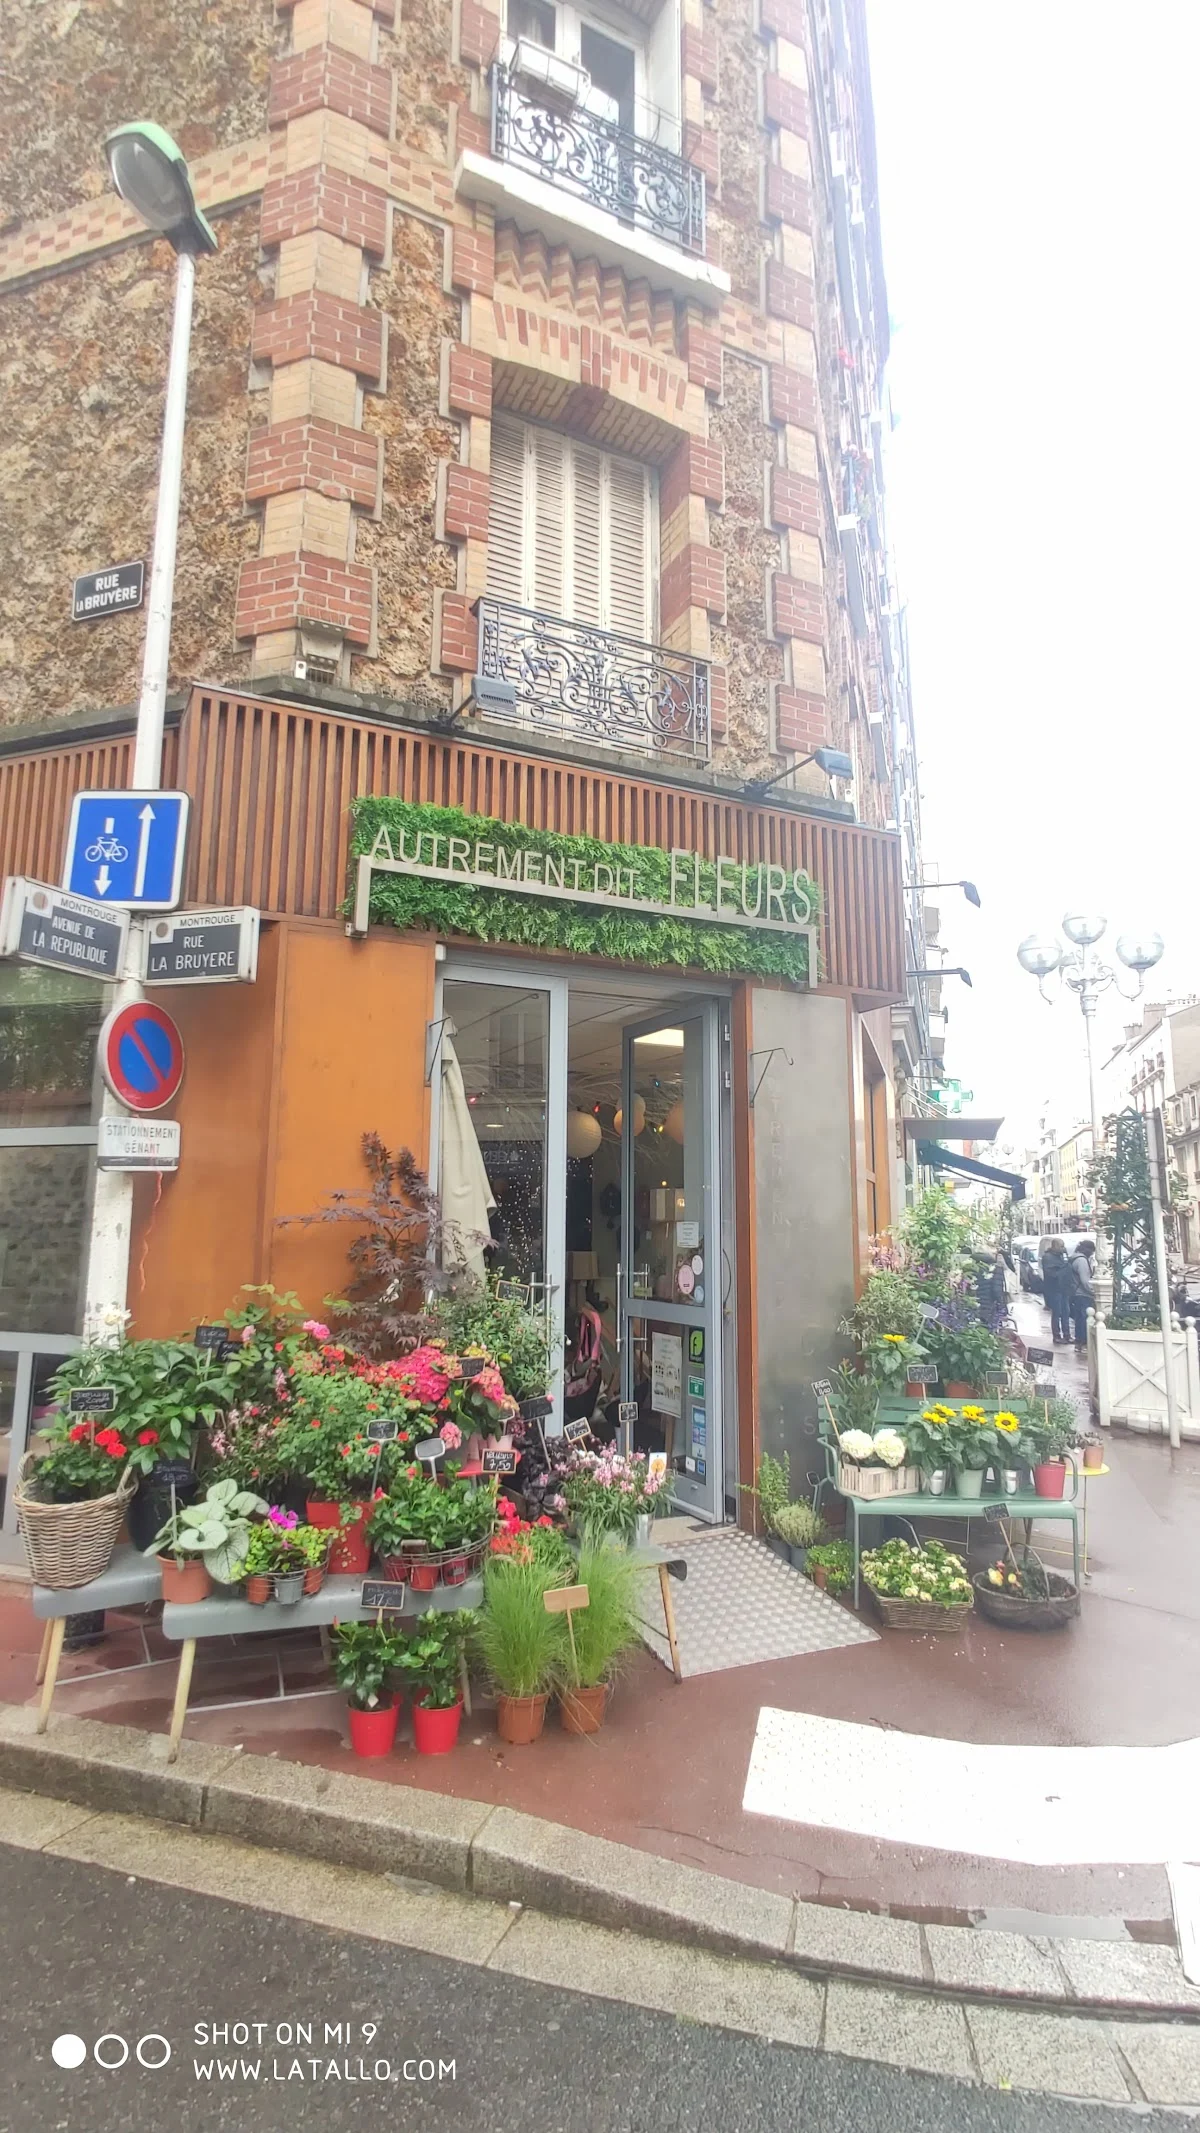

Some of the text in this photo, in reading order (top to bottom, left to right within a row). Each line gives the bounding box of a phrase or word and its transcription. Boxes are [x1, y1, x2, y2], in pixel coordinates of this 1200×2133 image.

[95, 573, 120, 591] RUE
[370, 825, 587, 892] AUTREMENT
[670, 847, 811, 926] FLEURS
[60, 897, 119, 923] MONTROUGE
[52, 915, 96, 940] AVENUE DE
[180, 914, 236, 927] MONTROUGE
[32, 930, 109, 965] LA REPUBLIQUE
[183, 935, 205, 949] RUE
[151, 951, 236, 972] LA BRUYERE
[106, 1124, 178, 1139] STATIONNEMENT
[124, 1139, 160, 1154] GÉNANT
[489, 1459, 511, 1471] 7,50
